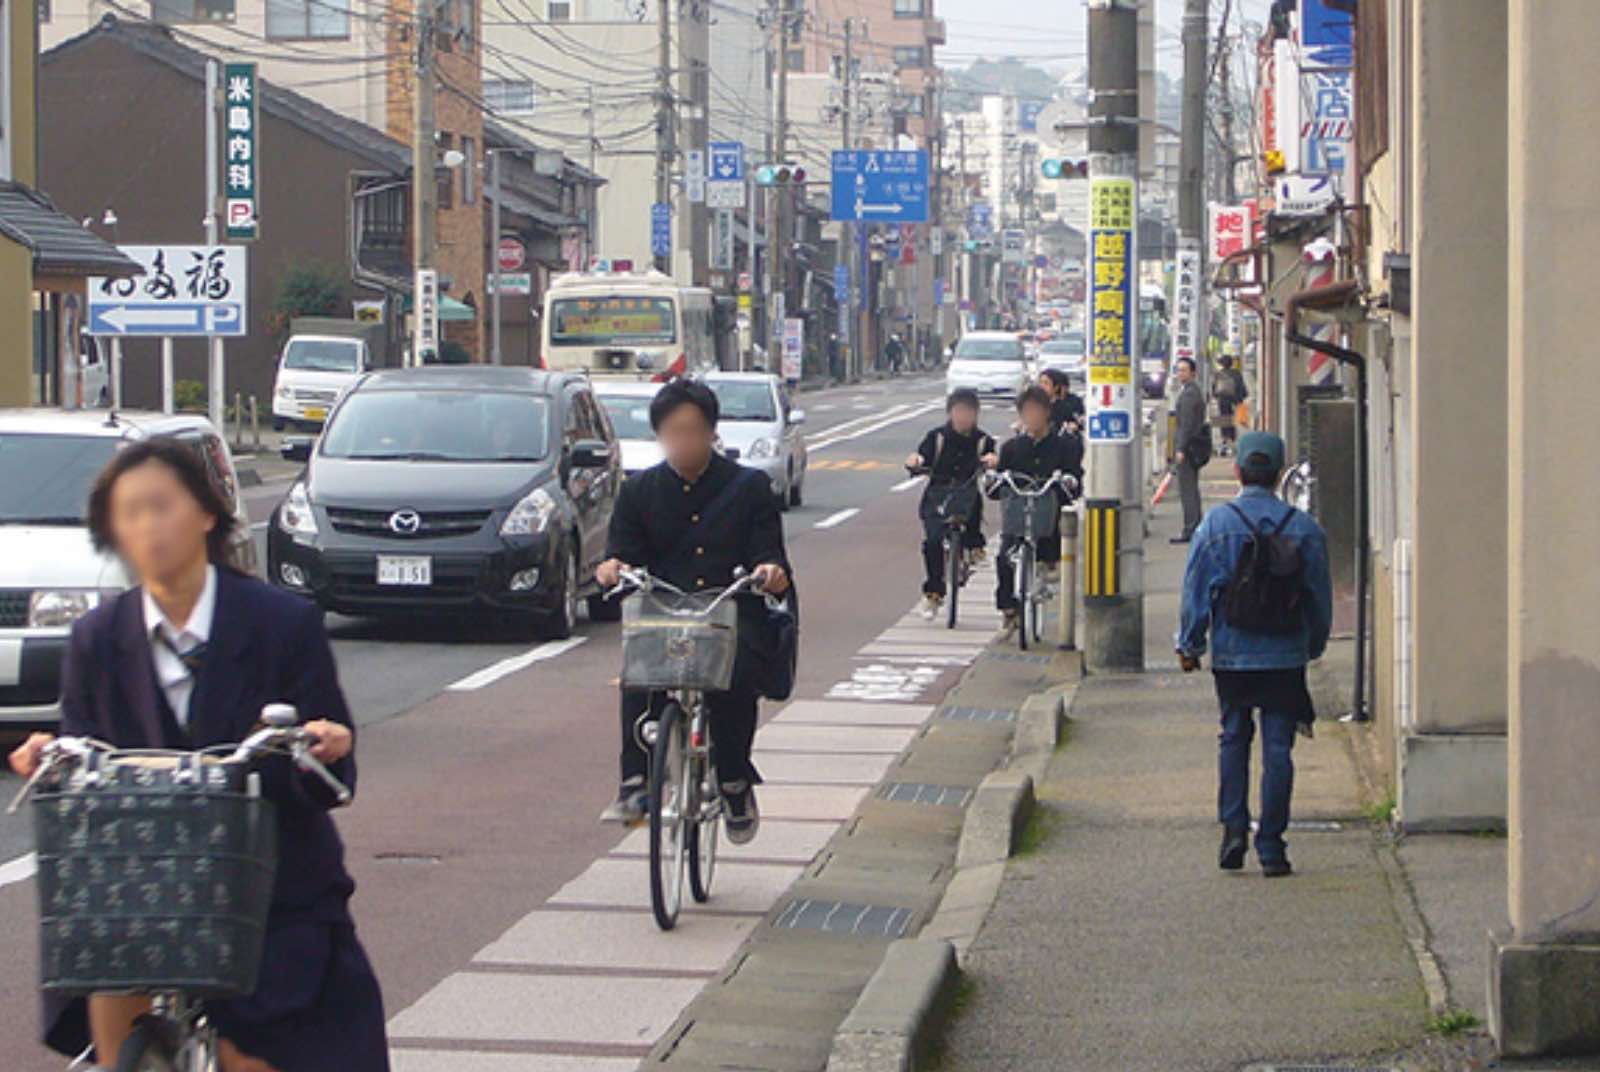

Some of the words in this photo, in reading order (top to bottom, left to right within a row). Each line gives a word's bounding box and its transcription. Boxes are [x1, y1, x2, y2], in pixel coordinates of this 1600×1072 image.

[228, 74, 252, 191] 米島内科
[230, 203, 250, 226] P
[204, 306, 238, 332] P
